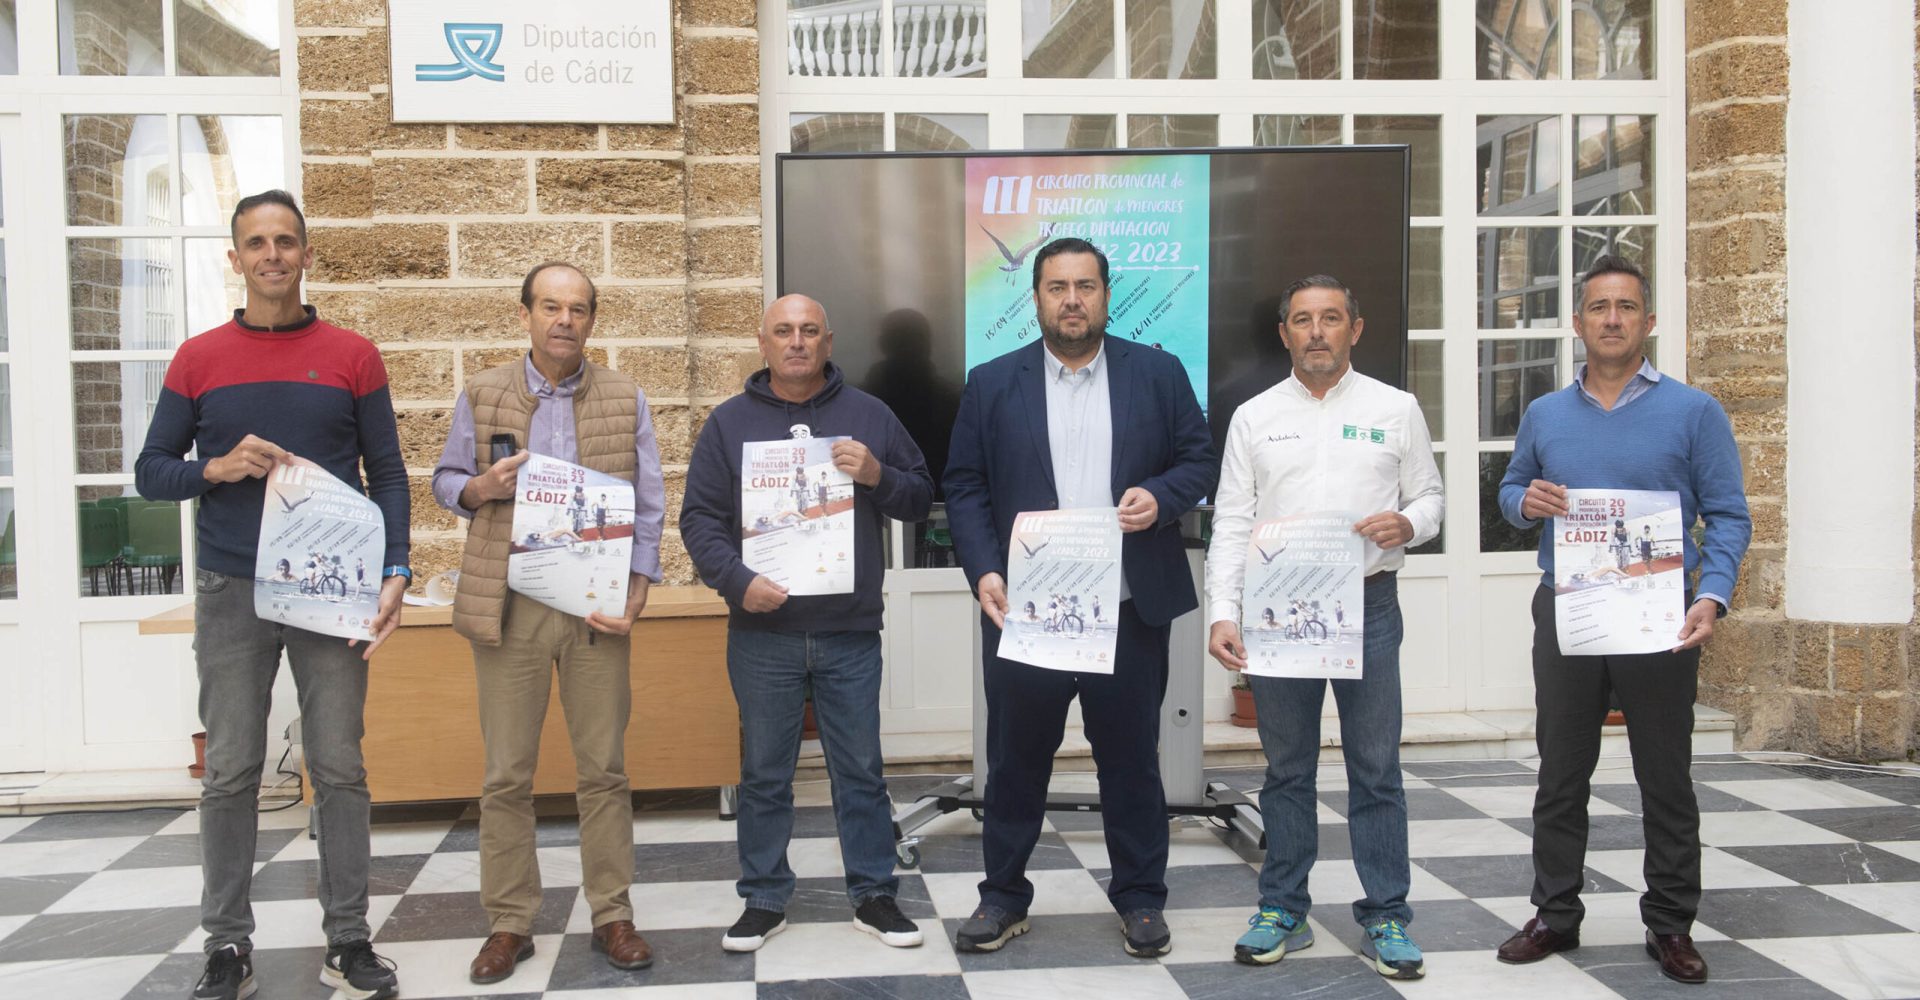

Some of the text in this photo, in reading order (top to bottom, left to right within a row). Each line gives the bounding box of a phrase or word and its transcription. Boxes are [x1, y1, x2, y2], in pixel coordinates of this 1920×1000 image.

[523, 23, 656, 52] Diputación
[525, 60, 634, 84] de Cádiz
[1036, 173, 1091, 190] CIRCUITO
[1094, 173, 1167, 190] PROVINCIAL
[982, 175, 1033, 214] III
[1038, 220, 1086, 237] TROFEO
[1127, 241, 1182, 264] 2023
[985, 316, 1008, 341] 15/04
[1130, 317, 1152, 340] 26/11
[791, 447, 806, 456] 20
[751, 460, 790, 469] TRIATLÓN
[791, 455, 805, 465] 23
[527, 473, 568, 485] TRIATLÓN
[571, 467, 585, 476] 20
[571, 475, 585, 484] 23
[751, 473, 790, 489] CÁDIZ
[526, 488, 567, 505] CÁDIZ
[1579, 498, 1606, 506] CIRCUITO
[1610, 498, 1625, 508] 20
[1564, 511, 1607, 521] TRIATLÓN
[1610, 507, 1625, 518] 23
[1564, 527, 1608, 543] CÁDIZ
